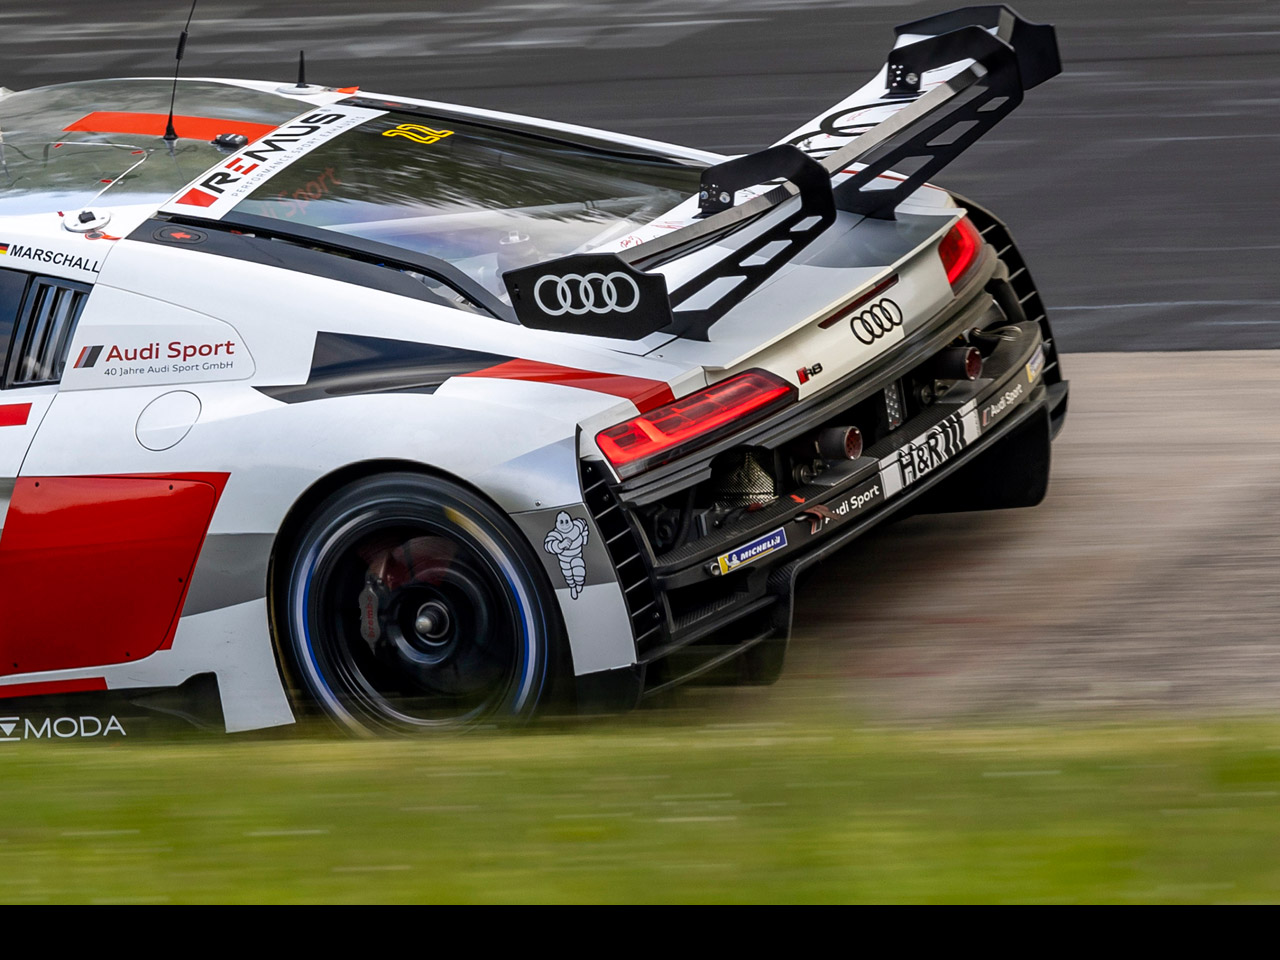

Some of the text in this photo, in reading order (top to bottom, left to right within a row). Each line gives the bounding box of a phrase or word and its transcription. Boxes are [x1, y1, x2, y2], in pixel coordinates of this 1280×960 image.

[200, 113, 346, 194] REMUS
[231, 155, 293, 197] PERFORMANCE
[291, 137, 320, 155] SPORT
[10, 244, 100, 274] MARSCHALL
[105, 341, 235, 362] Audi Sport
[104, 361, 233, 377] 40 Jahre Audi Sport GmbH
[990, 384, 1023, 417] Audi Sport
[899, 414, 960, 486] H&R
[850, 485, 880, 510] Sport
[740, 535, 781, 561] MICHELIN
[24, 715, 127, 740] MODA
